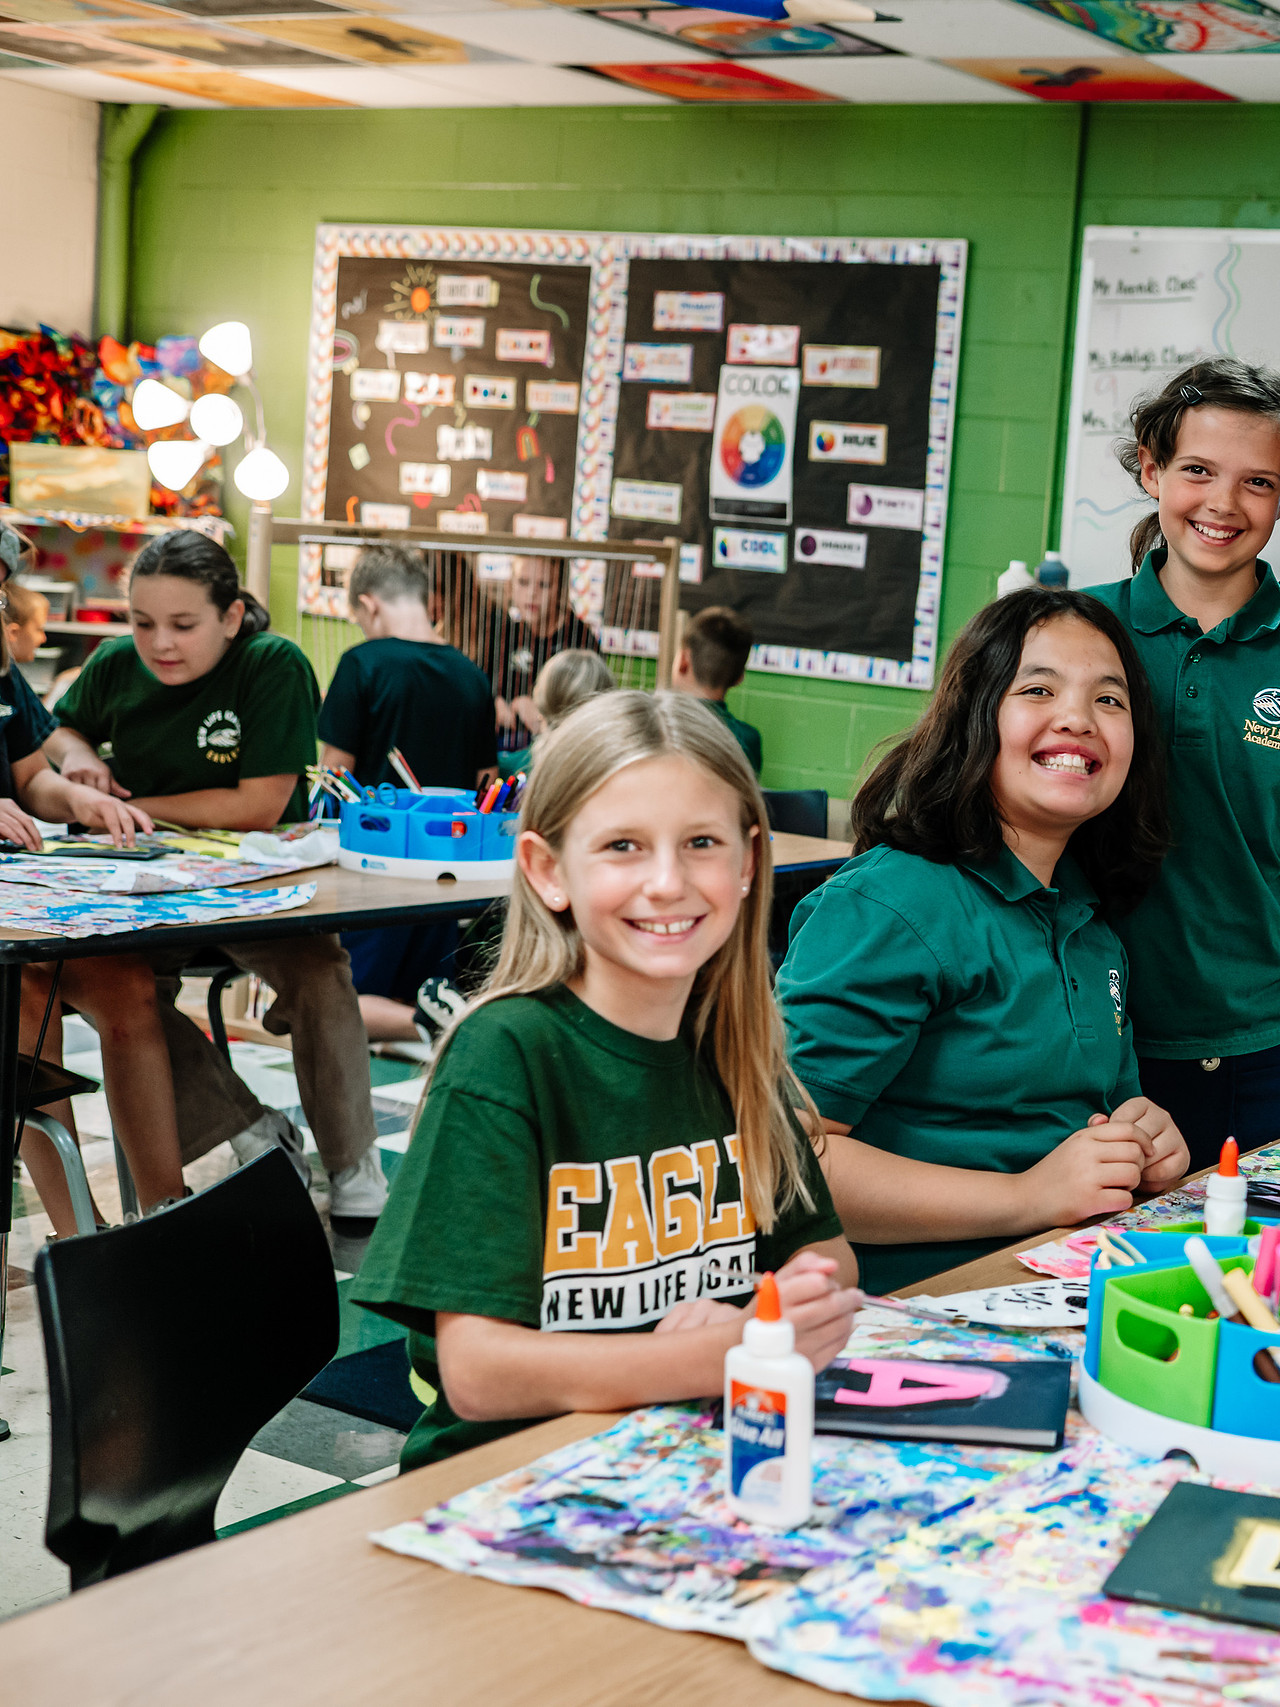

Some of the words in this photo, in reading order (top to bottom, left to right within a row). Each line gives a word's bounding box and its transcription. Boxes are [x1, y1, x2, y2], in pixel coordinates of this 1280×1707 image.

[724, 373, 793, 396] COLOR
[1243, 719, 1271, 736] New
[547, 1286, 625, 1323] NEW
[639, 1270, 687, 1315] LIFE
